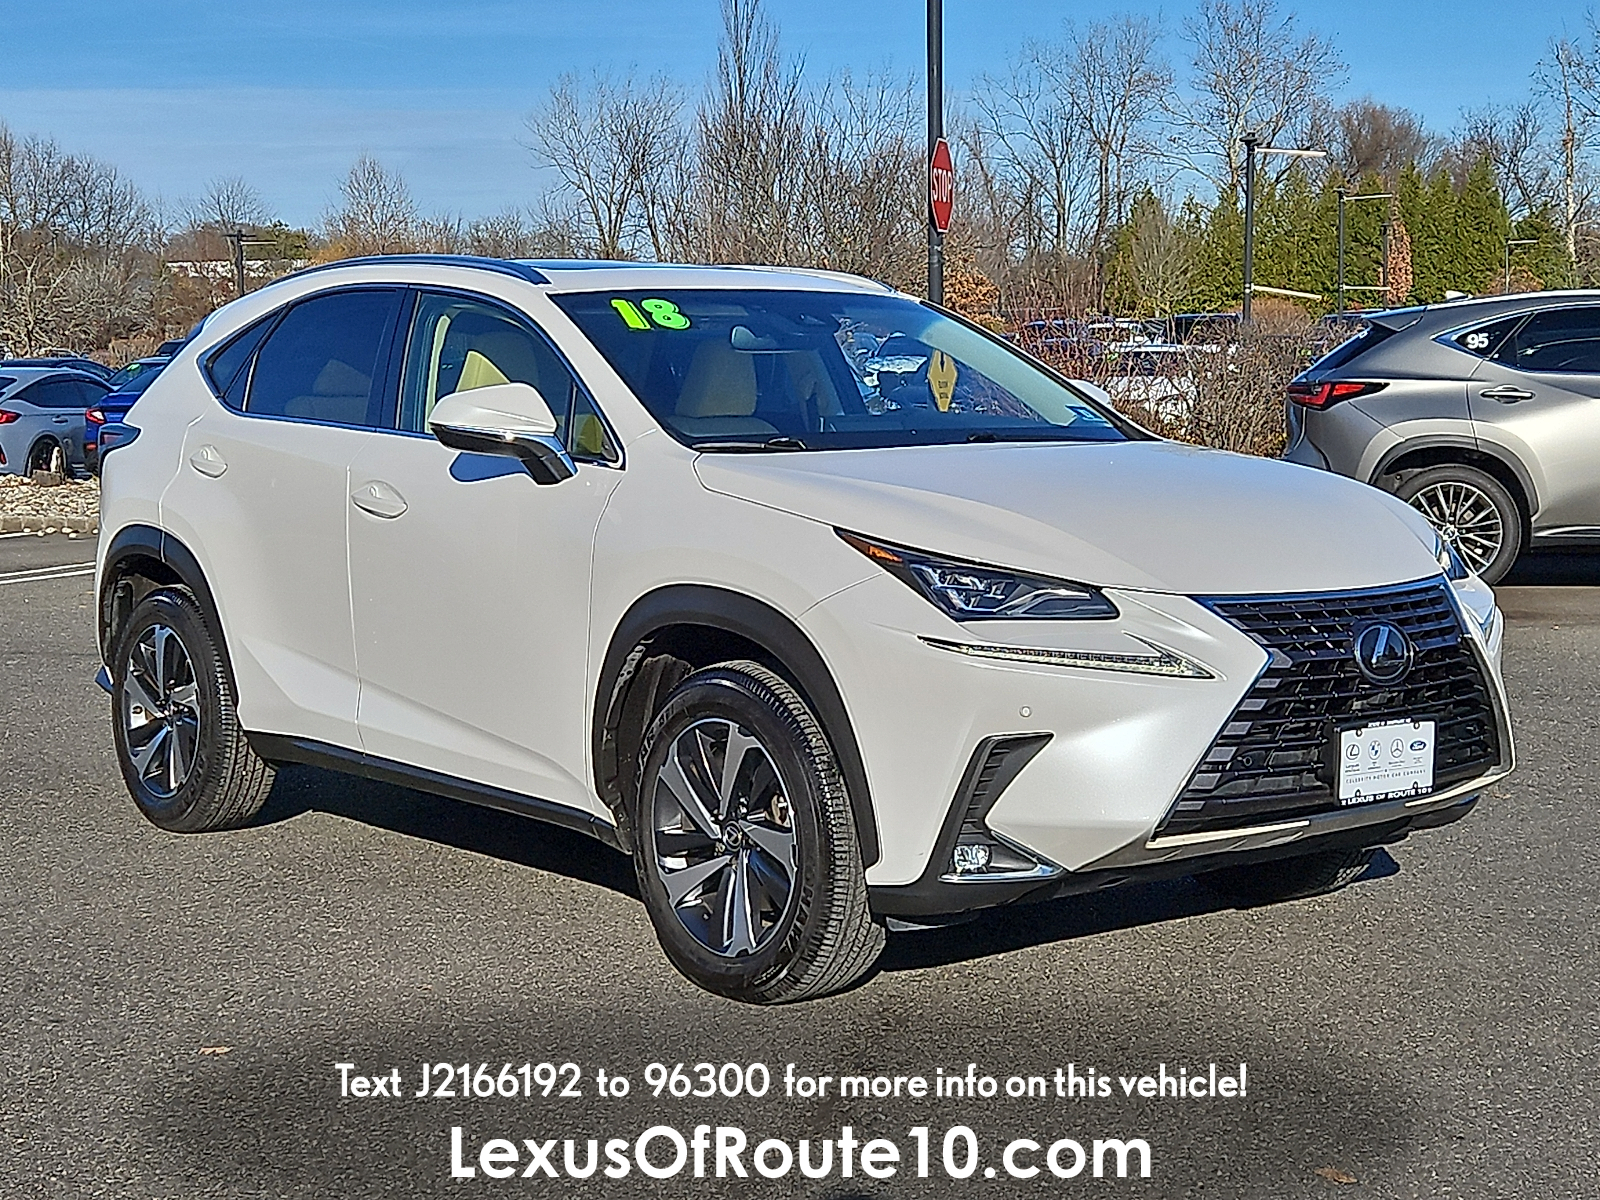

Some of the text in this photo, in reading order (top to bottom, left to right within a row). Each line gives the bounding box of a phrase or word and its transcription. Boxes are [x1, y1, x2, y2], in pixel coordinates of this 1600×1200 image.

[932, 167, 953, 203] STOP
[611, 299, 691, 330] 18
[1467, 333, 1489, 349] 95
[1348, 795, 1374, 804] LEXUS
[1376, 793, 1385, 801] OF
[1388, 789, 1416, 799] ROUTE
